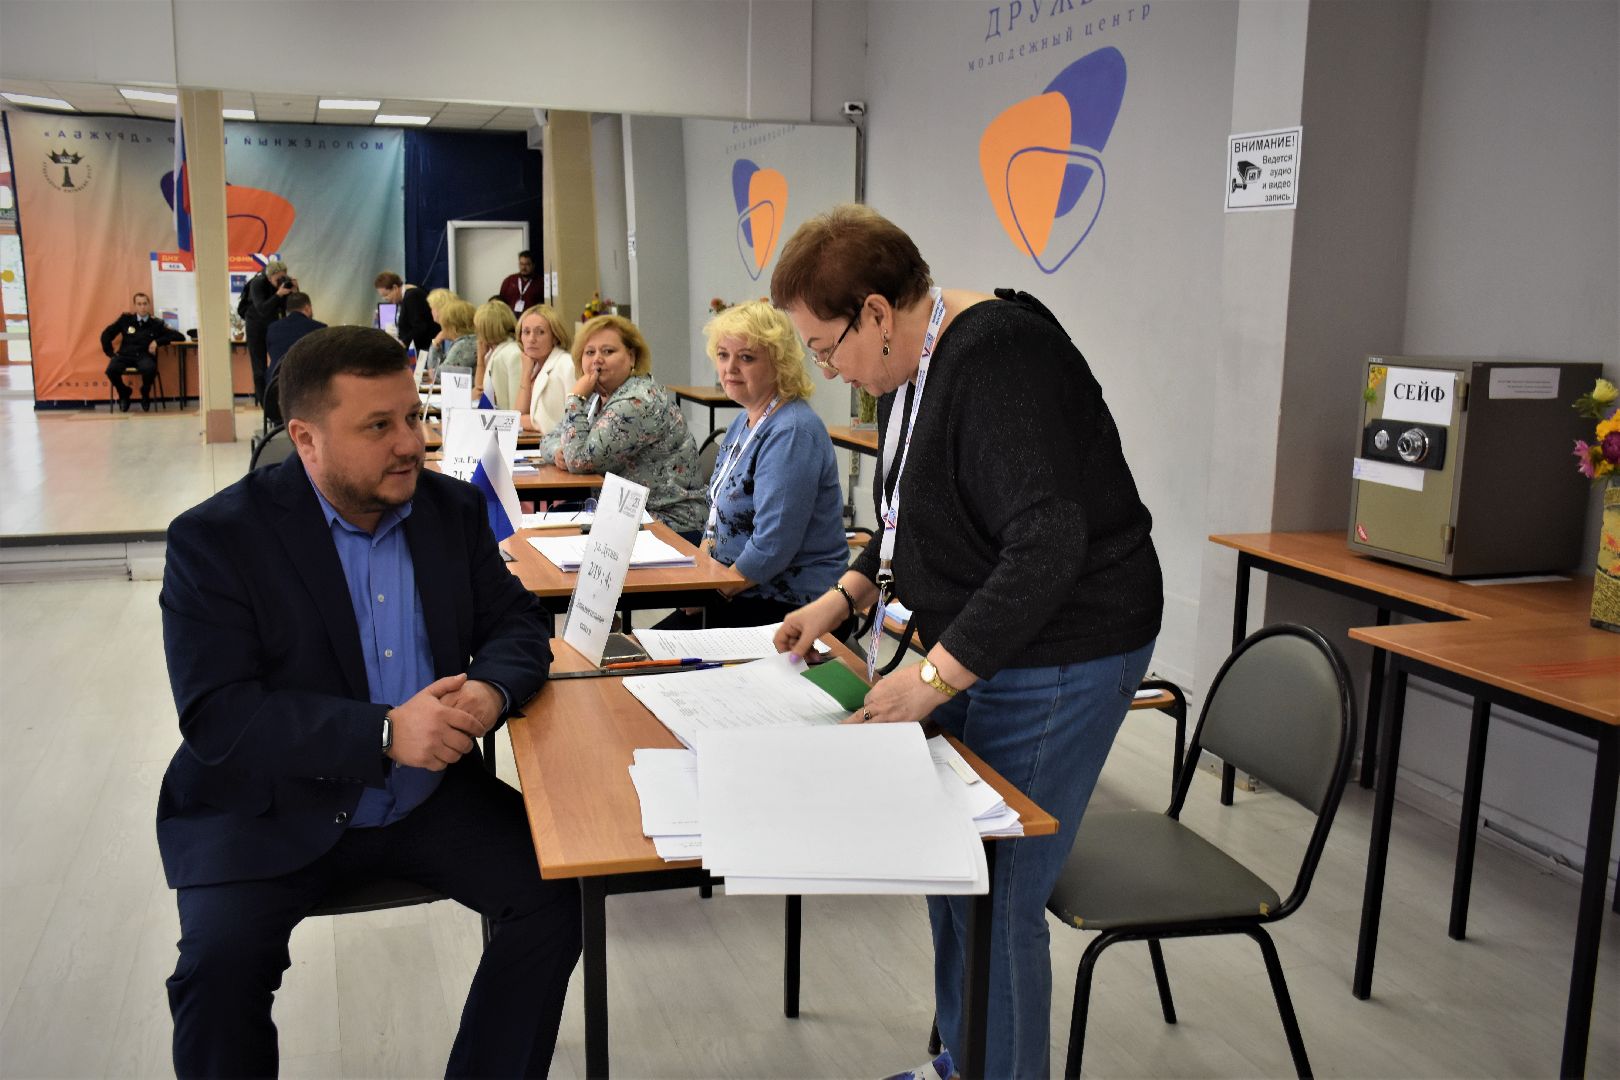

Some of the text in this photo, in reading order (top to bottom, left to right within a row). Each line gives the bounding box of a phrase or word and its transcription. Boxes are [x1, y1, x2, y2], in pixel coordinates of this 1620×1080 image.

[1234, 135, 1295, 153] ВНИМАНИЕ!
[1262, 154, 1293, 165] Ведется
[1269, 167, 1292, 178] аудио
[1262, 180, 1291, 190] и видео
[1264, 193, 1291, 202] запись
[1393, 380, 1446, 403] СЕЙФ
